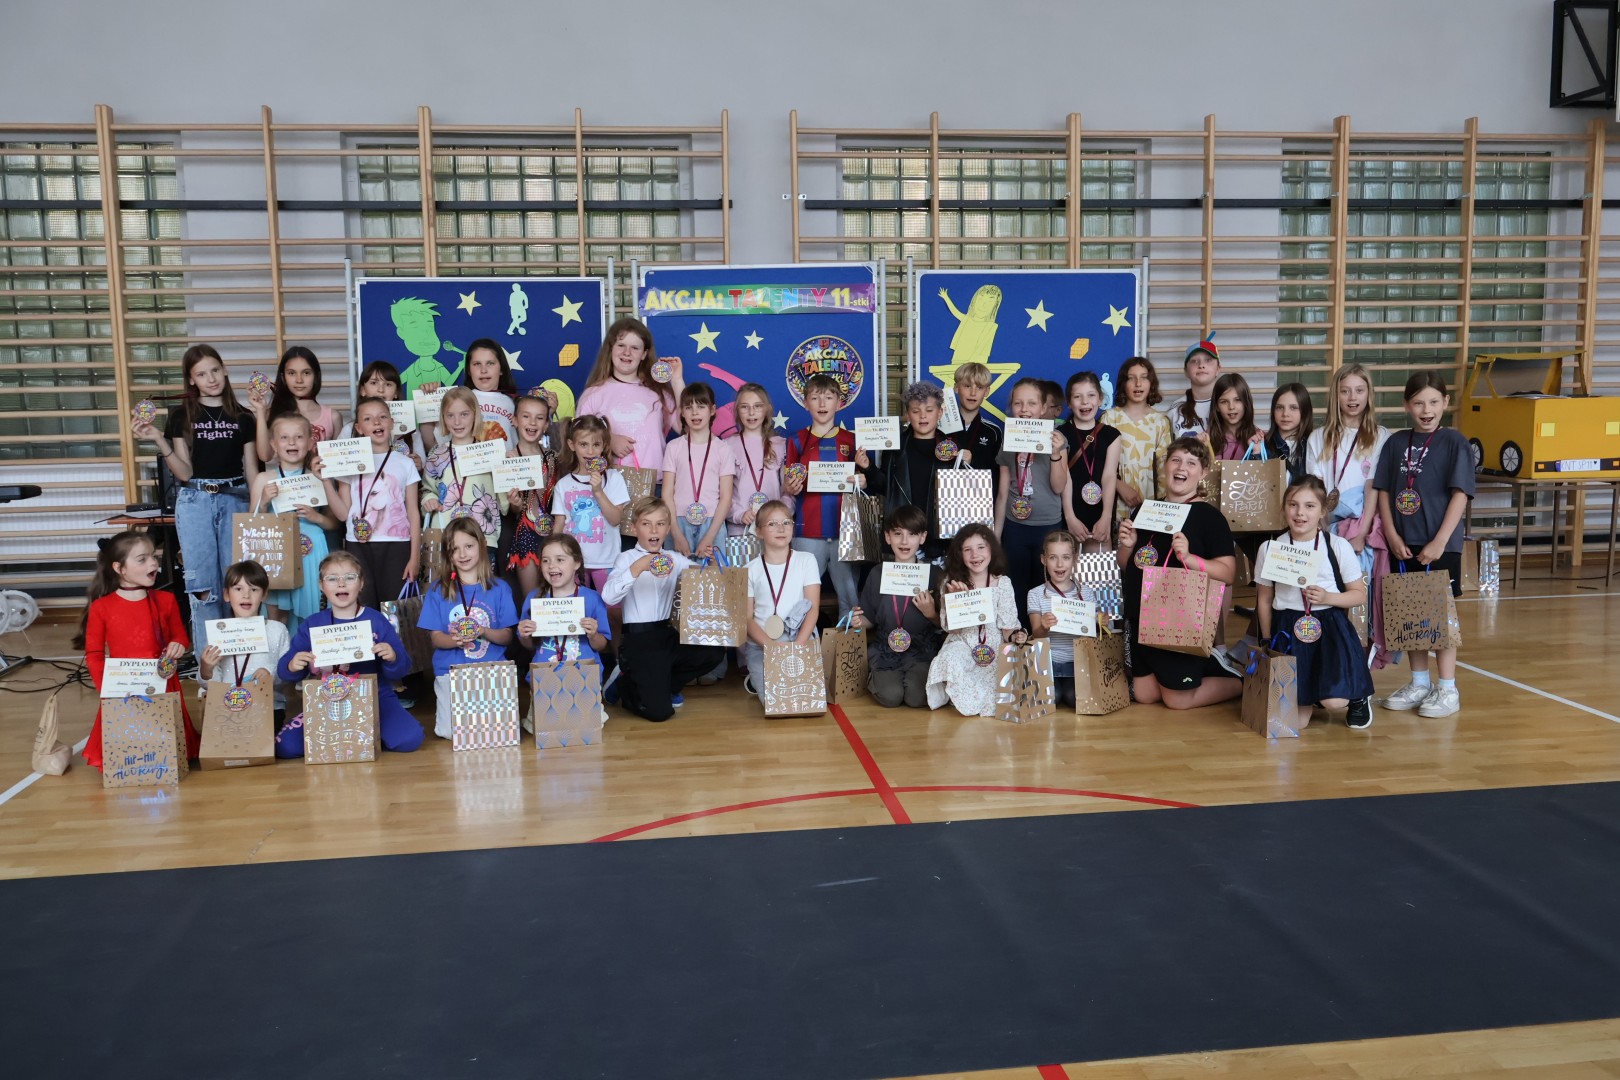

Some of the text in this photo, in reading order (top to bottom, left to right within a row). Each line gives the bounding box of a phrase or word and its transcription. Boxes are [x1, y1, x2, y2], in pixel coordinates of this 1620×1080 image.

[644, 288, 869, 310] AKCJA: TALENTY 11-stki
[805, 348, 848, 361] AKCJA
[802, 360, 854, 375] TALENTY
[949, 396, 959, 422] DYPLOM
[214, 420, 239, 429] idea
[197, 430, 234, 440] right?
[329, 440, 360, 448] DYPLOM
[466, 442, 494, 452] DYPLOM
[502, 457, 531, 465] DYPLOM
[280, 476, 311, 485] DYPLOM
[1152, 502, 1181, 510] DYPLOM
[1280, 545, 1311, 557] DYPLOM
[1061, 599, 1086, 608] DYPLOM
[323, 625, 357, 634] DYPLOM
